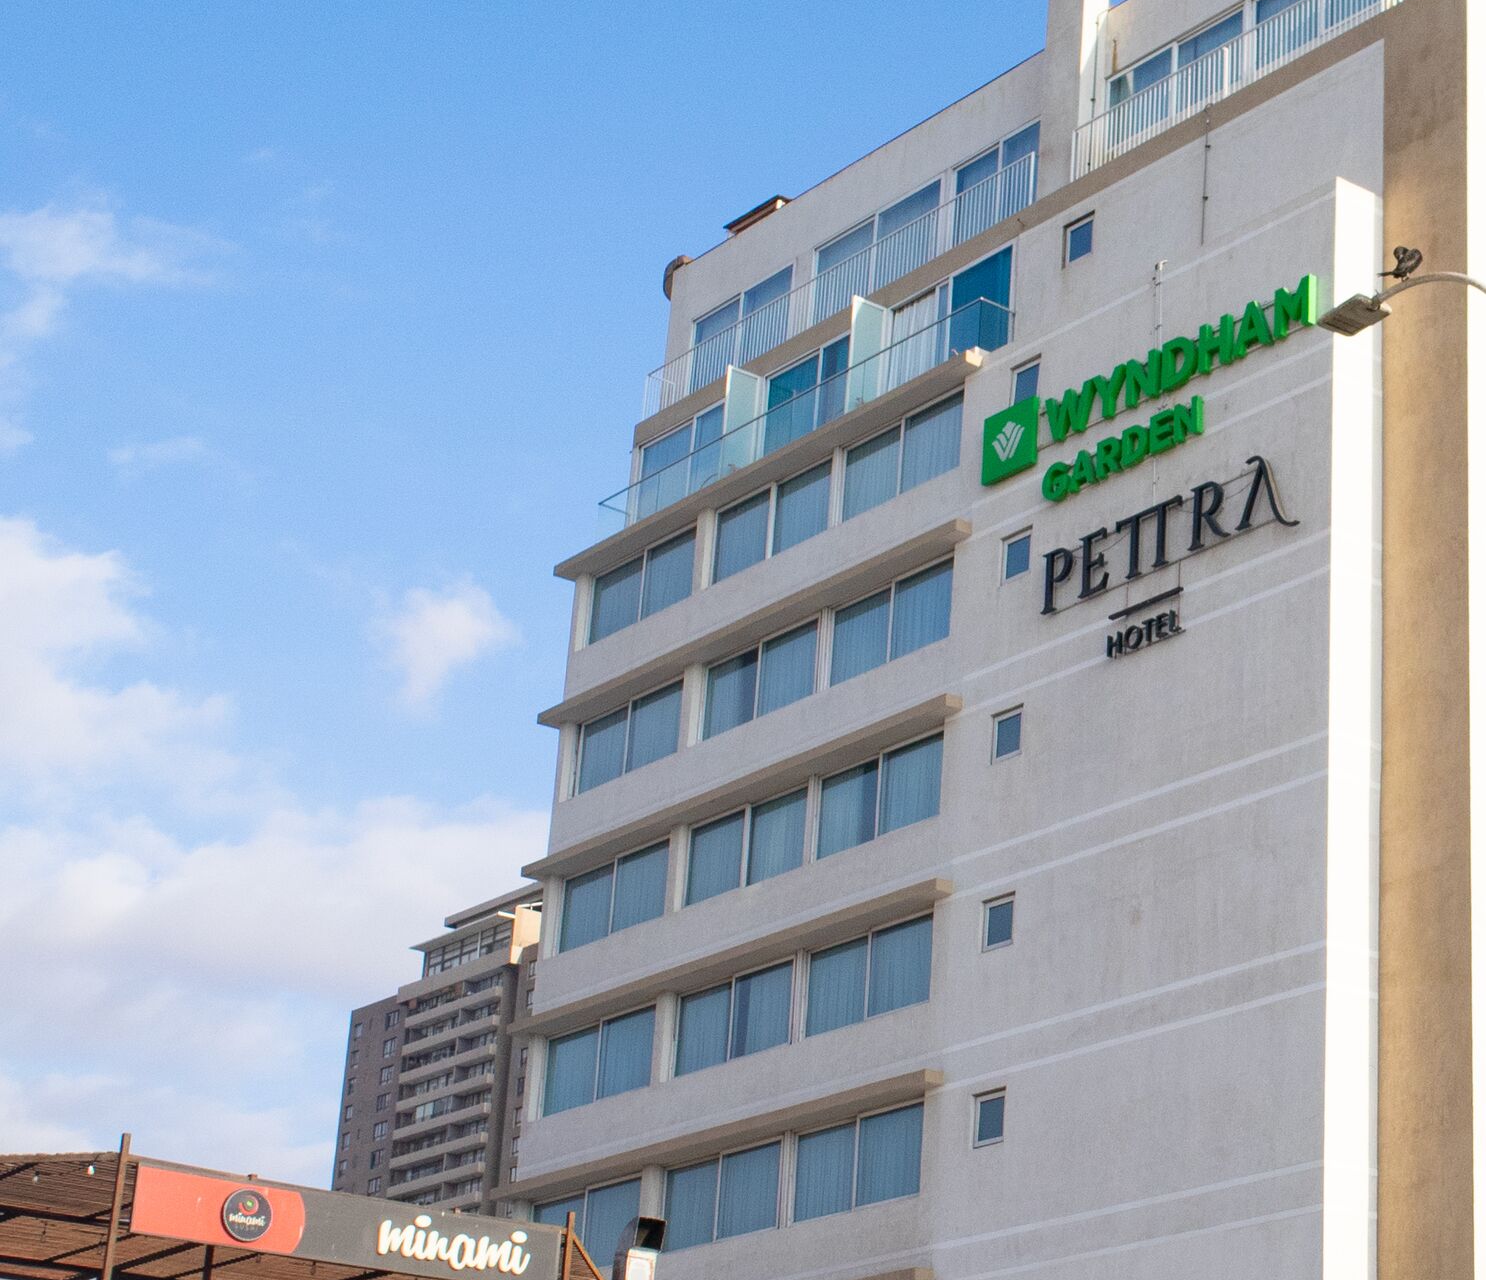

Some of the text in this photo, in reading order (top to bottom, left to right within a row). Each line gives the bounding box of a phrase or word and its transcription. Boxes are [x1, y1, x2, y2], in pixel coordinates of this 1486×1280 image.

[1045, 273, 1318, 442] WYNDHAM
[1041, 395, 1205, 502] GARDEN
[1106, 609, 1185, 658] HOTEL
[376, 1214, 531, 1275] minami
